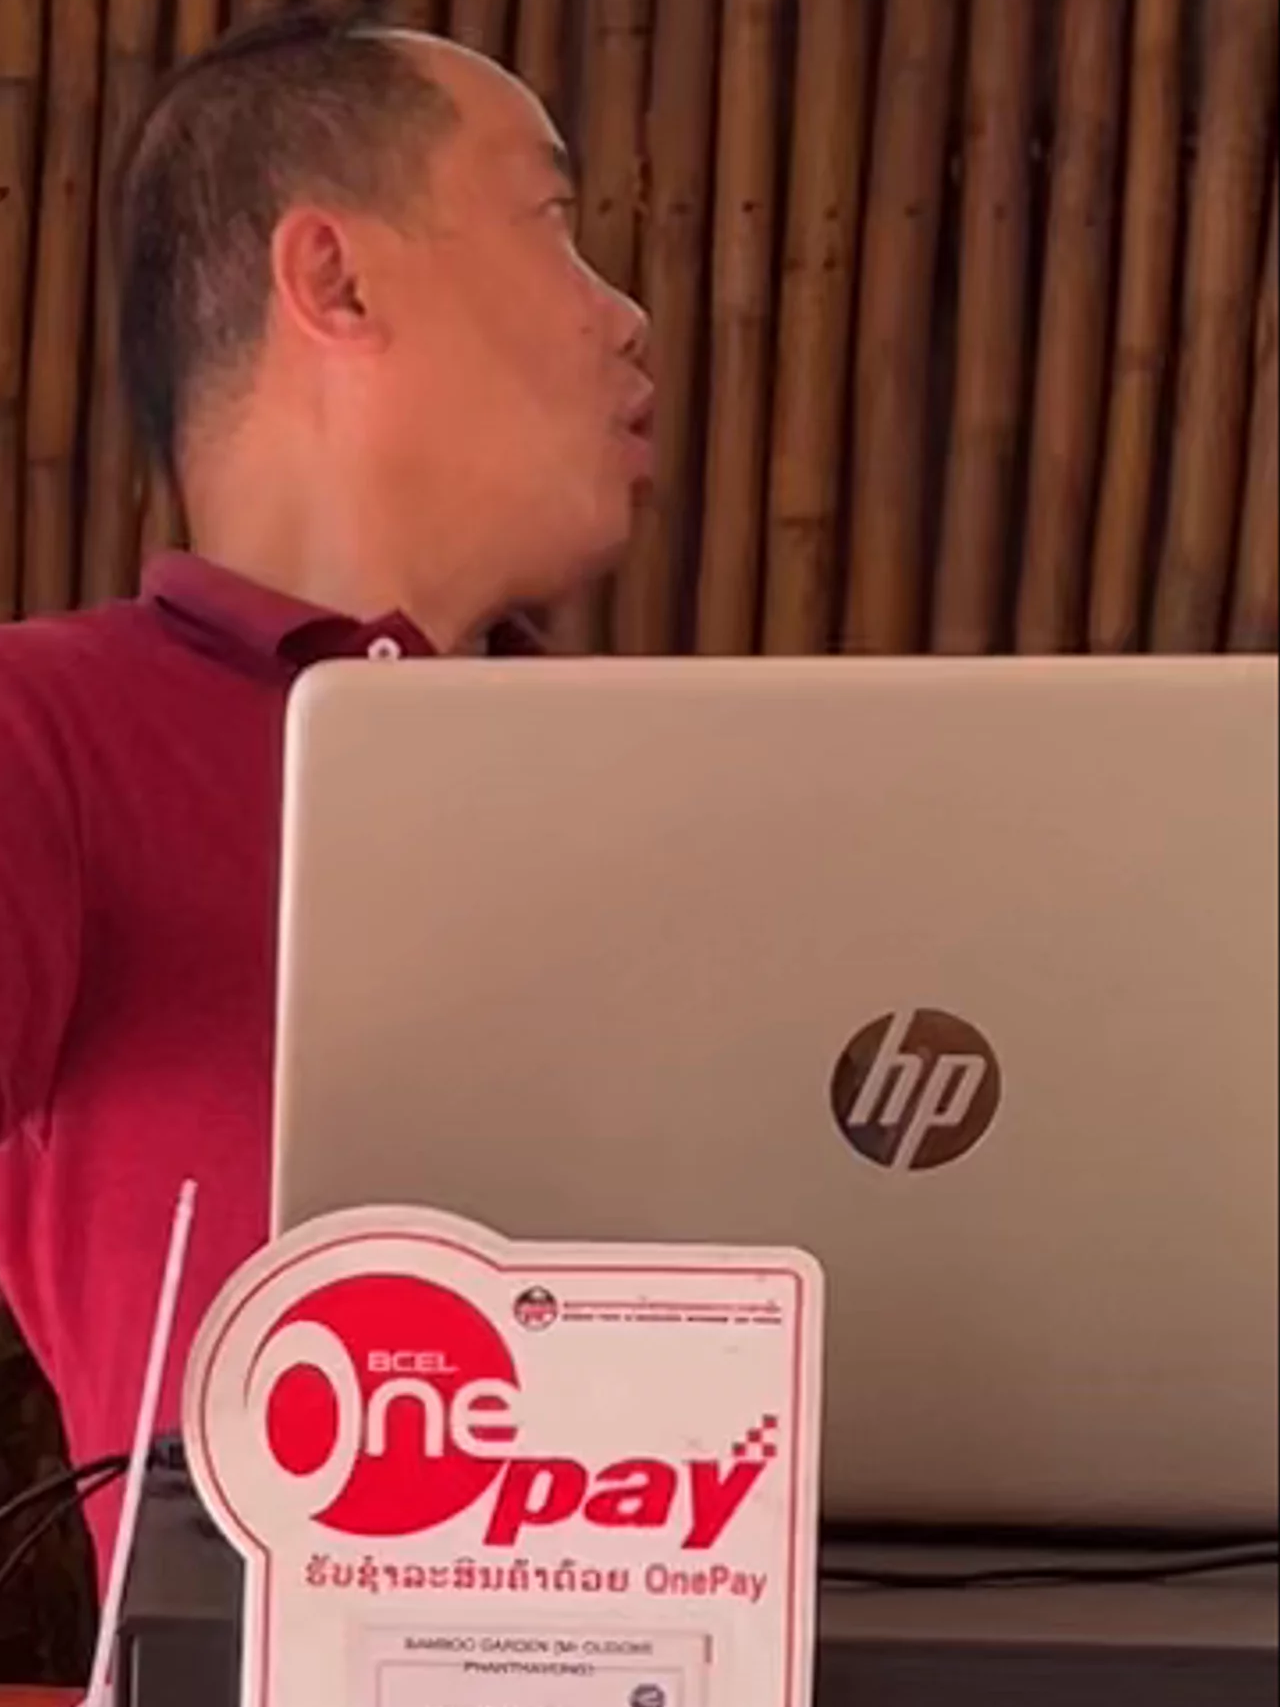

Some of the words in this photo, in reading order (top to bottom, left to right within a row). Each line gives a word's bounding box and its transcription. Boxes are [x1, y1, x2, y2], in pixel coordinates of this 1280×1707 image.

[847, 1009, 988, 1170] hp
[367, 1350, 458, 1373] BCEL
[246, 1318, 522, 1519] One
[482, 1453, 772, 1549] pay
[644, 1562, 767, 1604] OnePay
